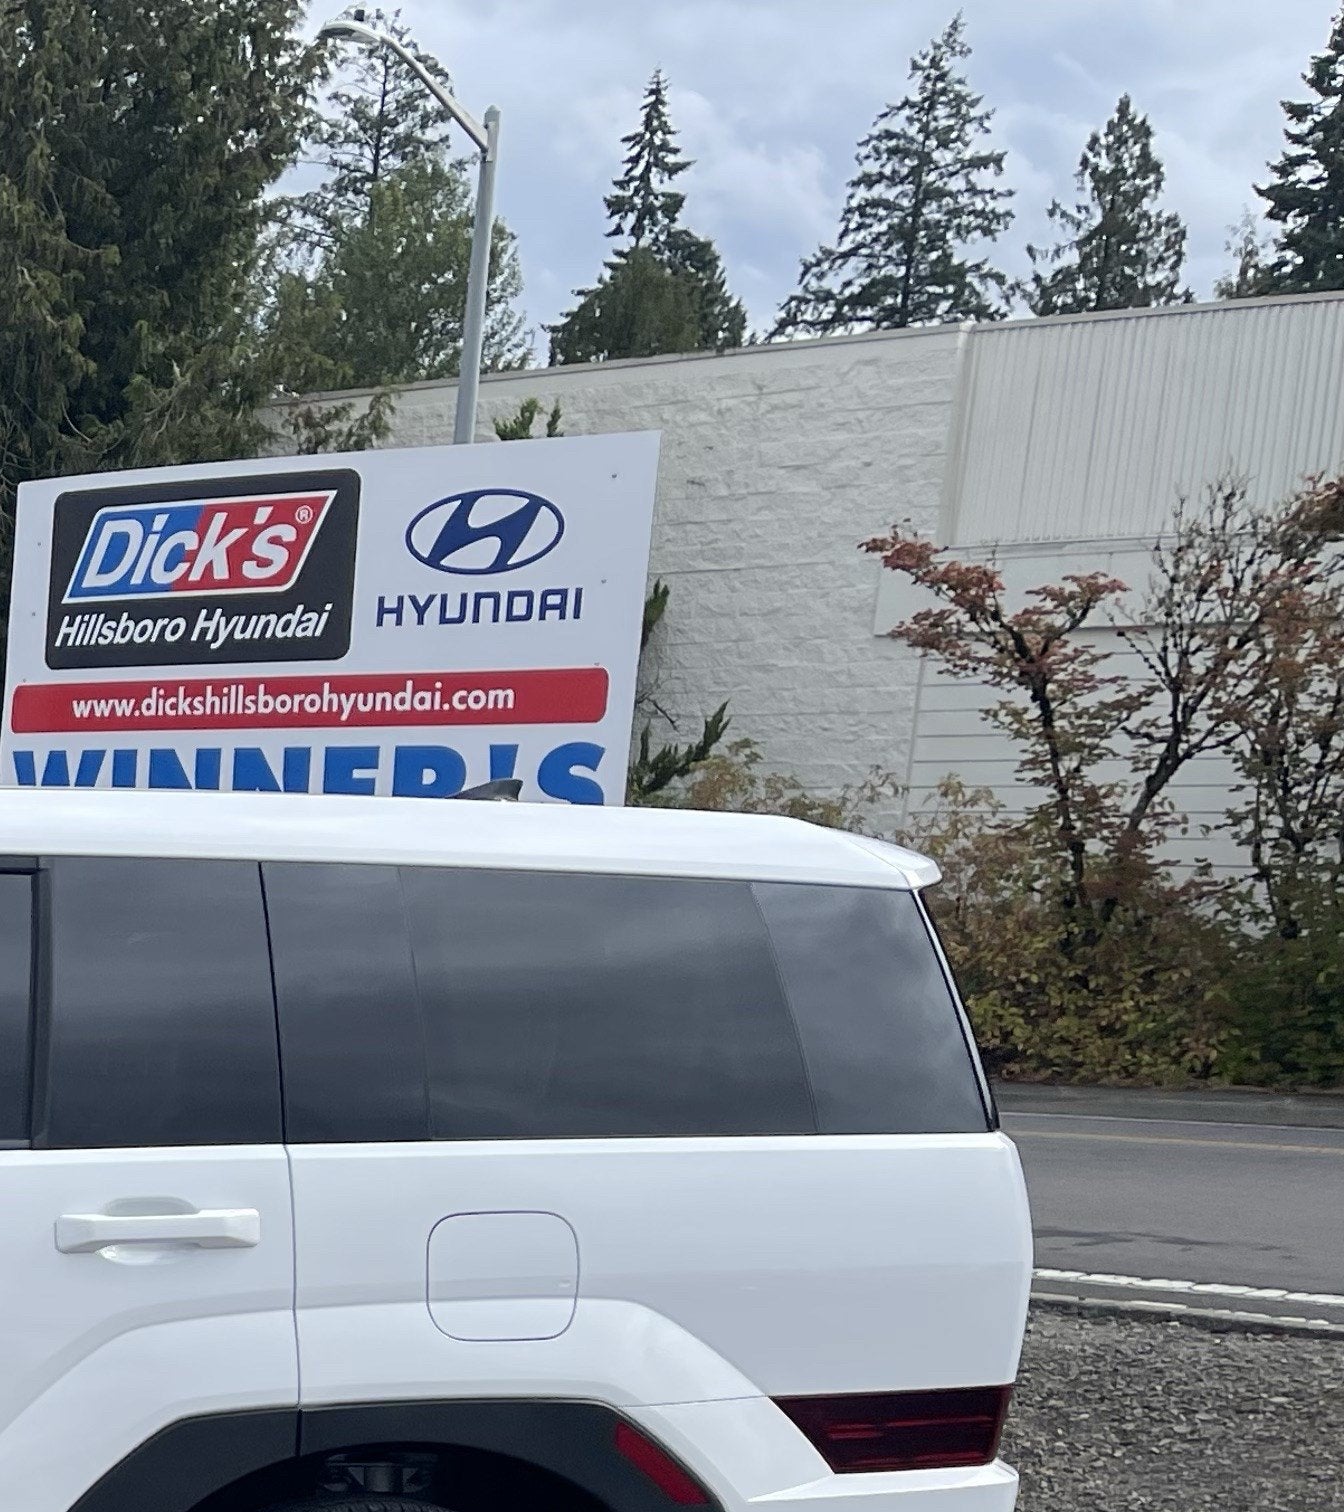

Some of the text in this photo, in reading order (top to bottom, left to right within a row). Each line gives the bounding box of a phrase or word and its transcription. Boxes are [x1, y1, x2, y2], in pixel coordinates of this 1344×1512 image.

[55, 602, 333, 650] Hillsboro Hyundai
[376, 587, 583, 627] HYUNDAI
[71, 679, 515, 722] www.dickshillsborohyundai.com
